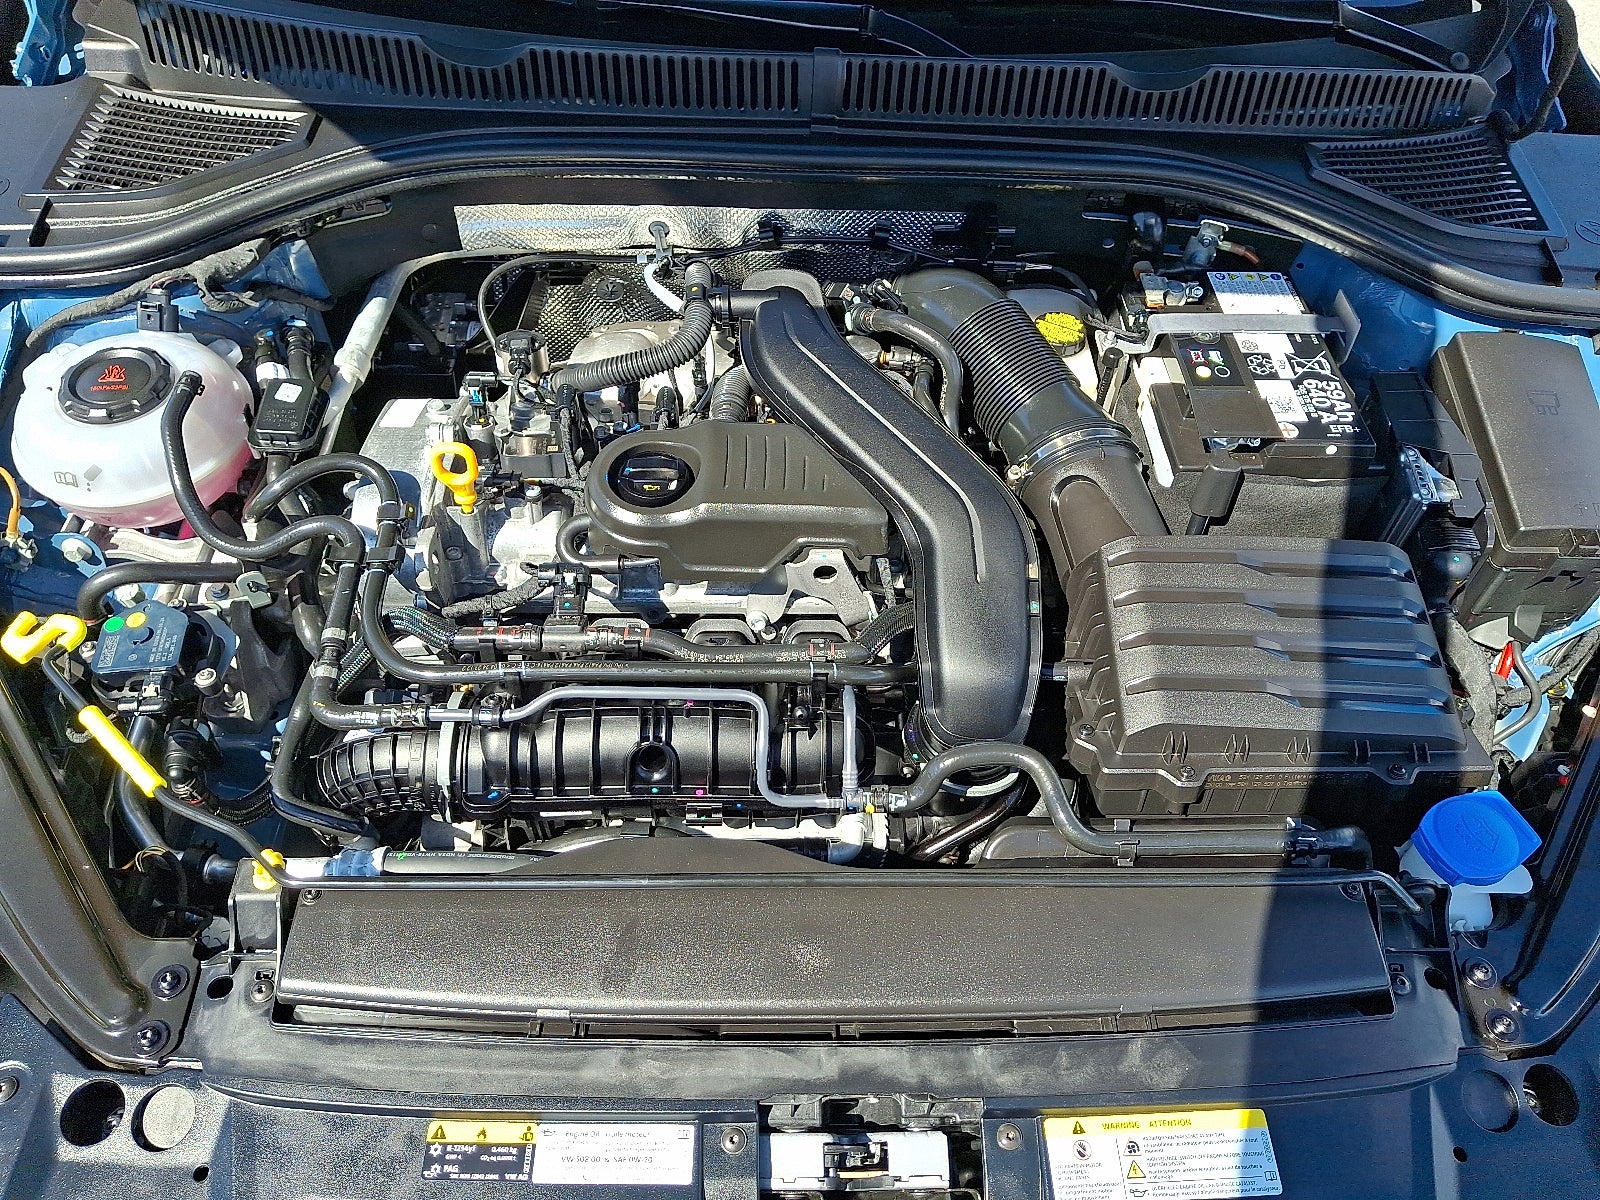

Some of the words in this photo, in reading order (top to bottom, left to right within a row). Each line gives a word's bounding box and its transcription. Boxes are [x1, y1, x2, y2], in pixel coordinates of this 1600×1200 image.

[1303, 378, 1332, 409] 640
[1329, 424, 1361, 433] EFB+
[1102, 1120, 1141, 1130] WARNING
[1149, 1118, 1192, 1128] ATTENTION
[443, 1164, 459, 1173] PAG
